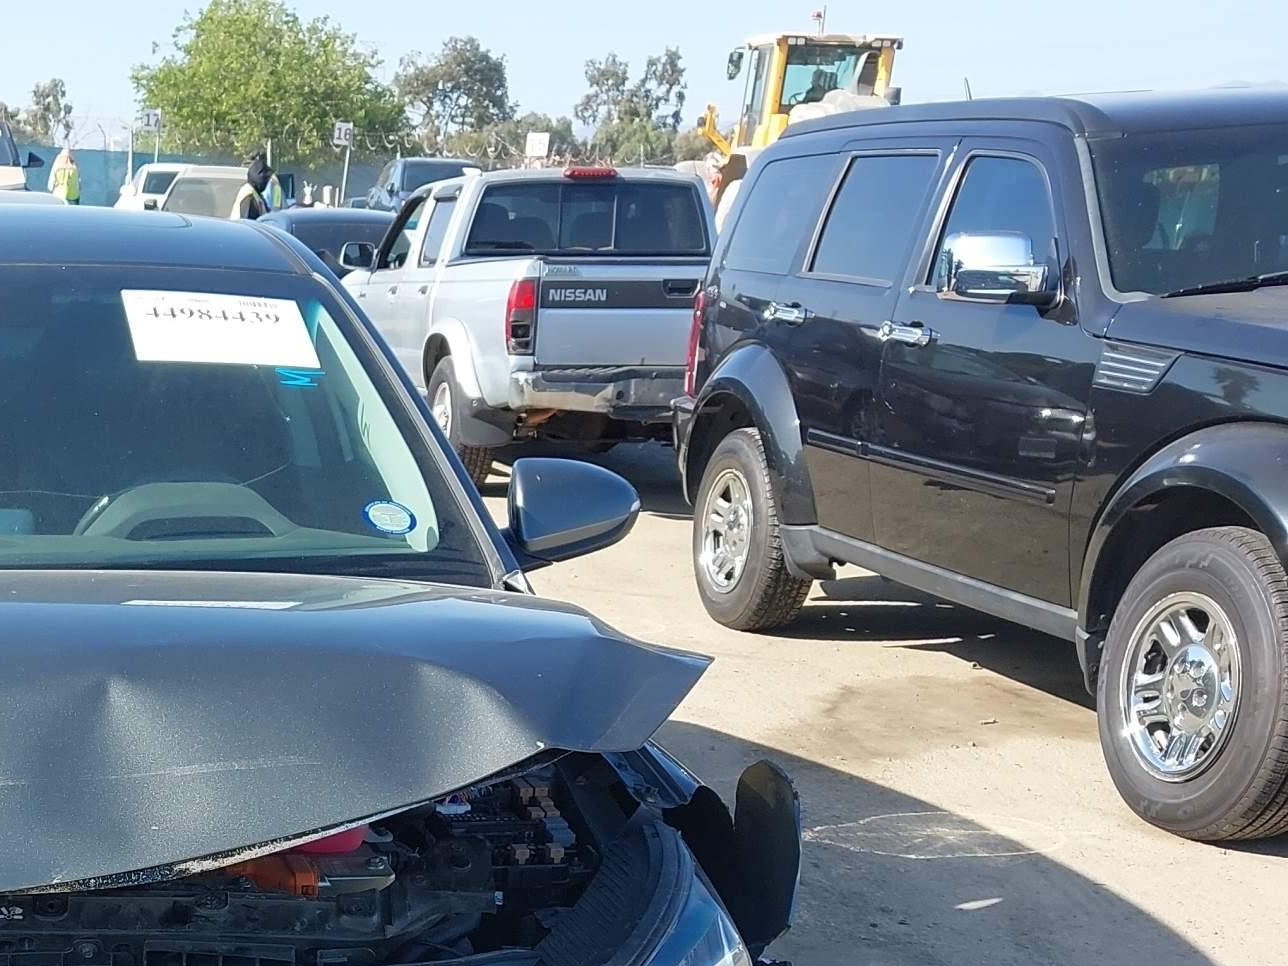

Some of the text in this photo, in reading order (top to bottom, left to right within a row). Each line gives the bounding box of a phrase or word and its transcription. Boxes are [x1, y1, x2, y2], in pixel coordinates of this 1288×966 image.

[144, 113, 160, 128] 17
[336, 127, 352, 141] 16
[548, 288, 608, 302] NISSAN
